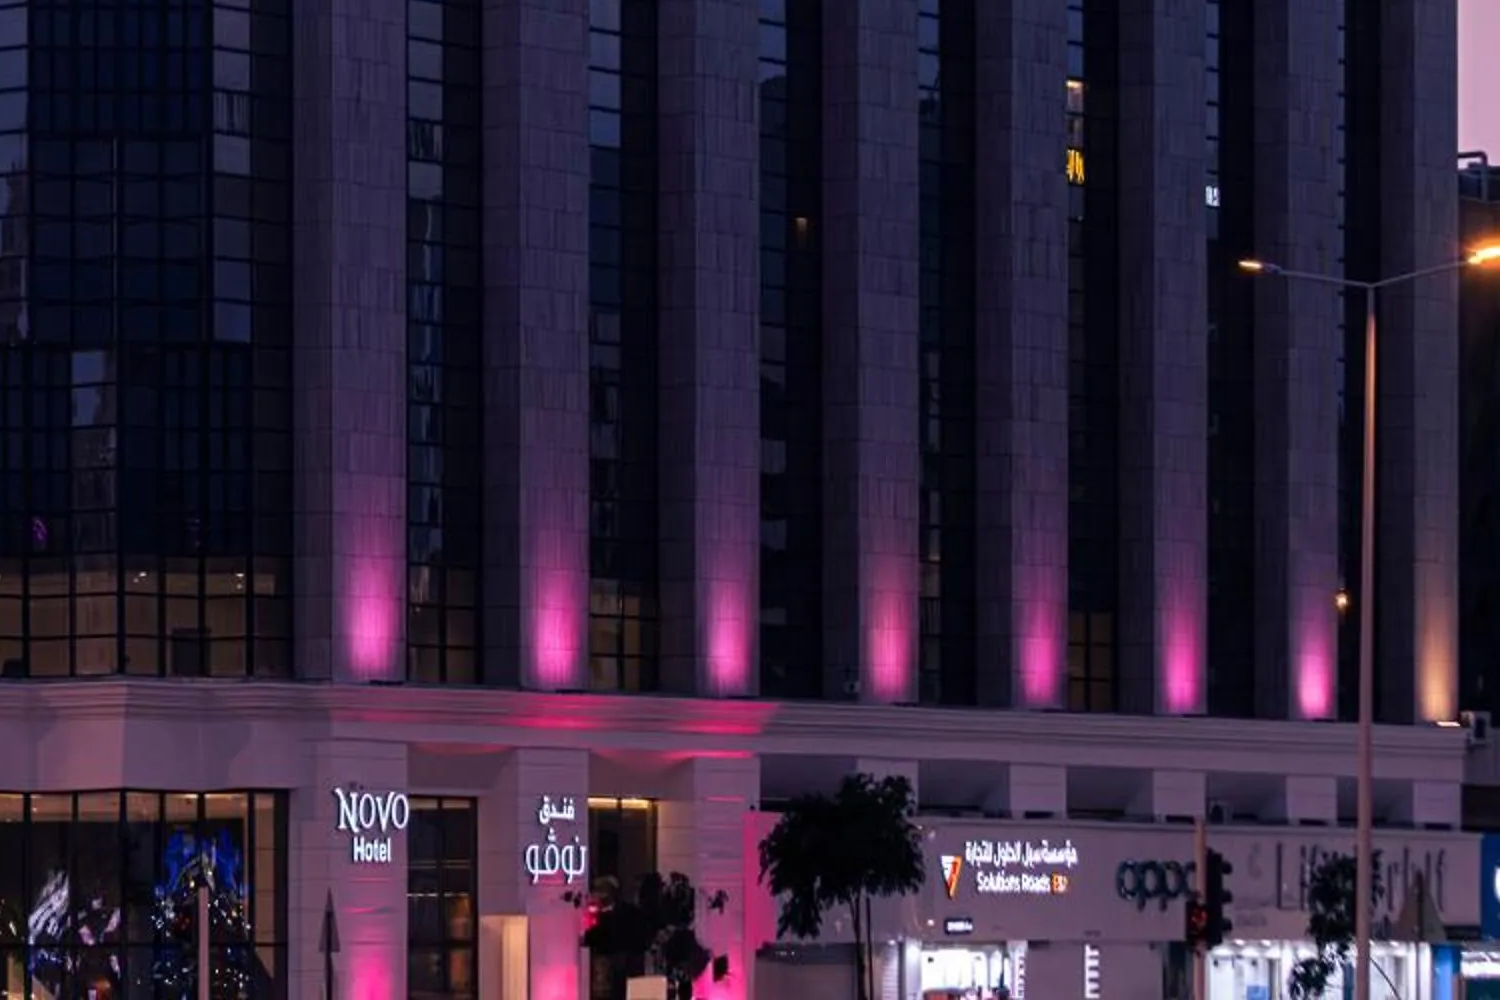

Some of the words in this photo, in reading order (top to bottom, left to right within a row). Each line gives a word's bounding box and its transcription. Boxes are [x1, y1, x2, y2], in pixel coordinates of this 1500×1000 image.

[334, 787, 409, 833] NOVO
[539, 795, 575, 825] فندق
[353, 836, 392, 864] Hotel
[977, 870, 1020, 893] Solutions
[1021, 873, 1050, 892] Roads
